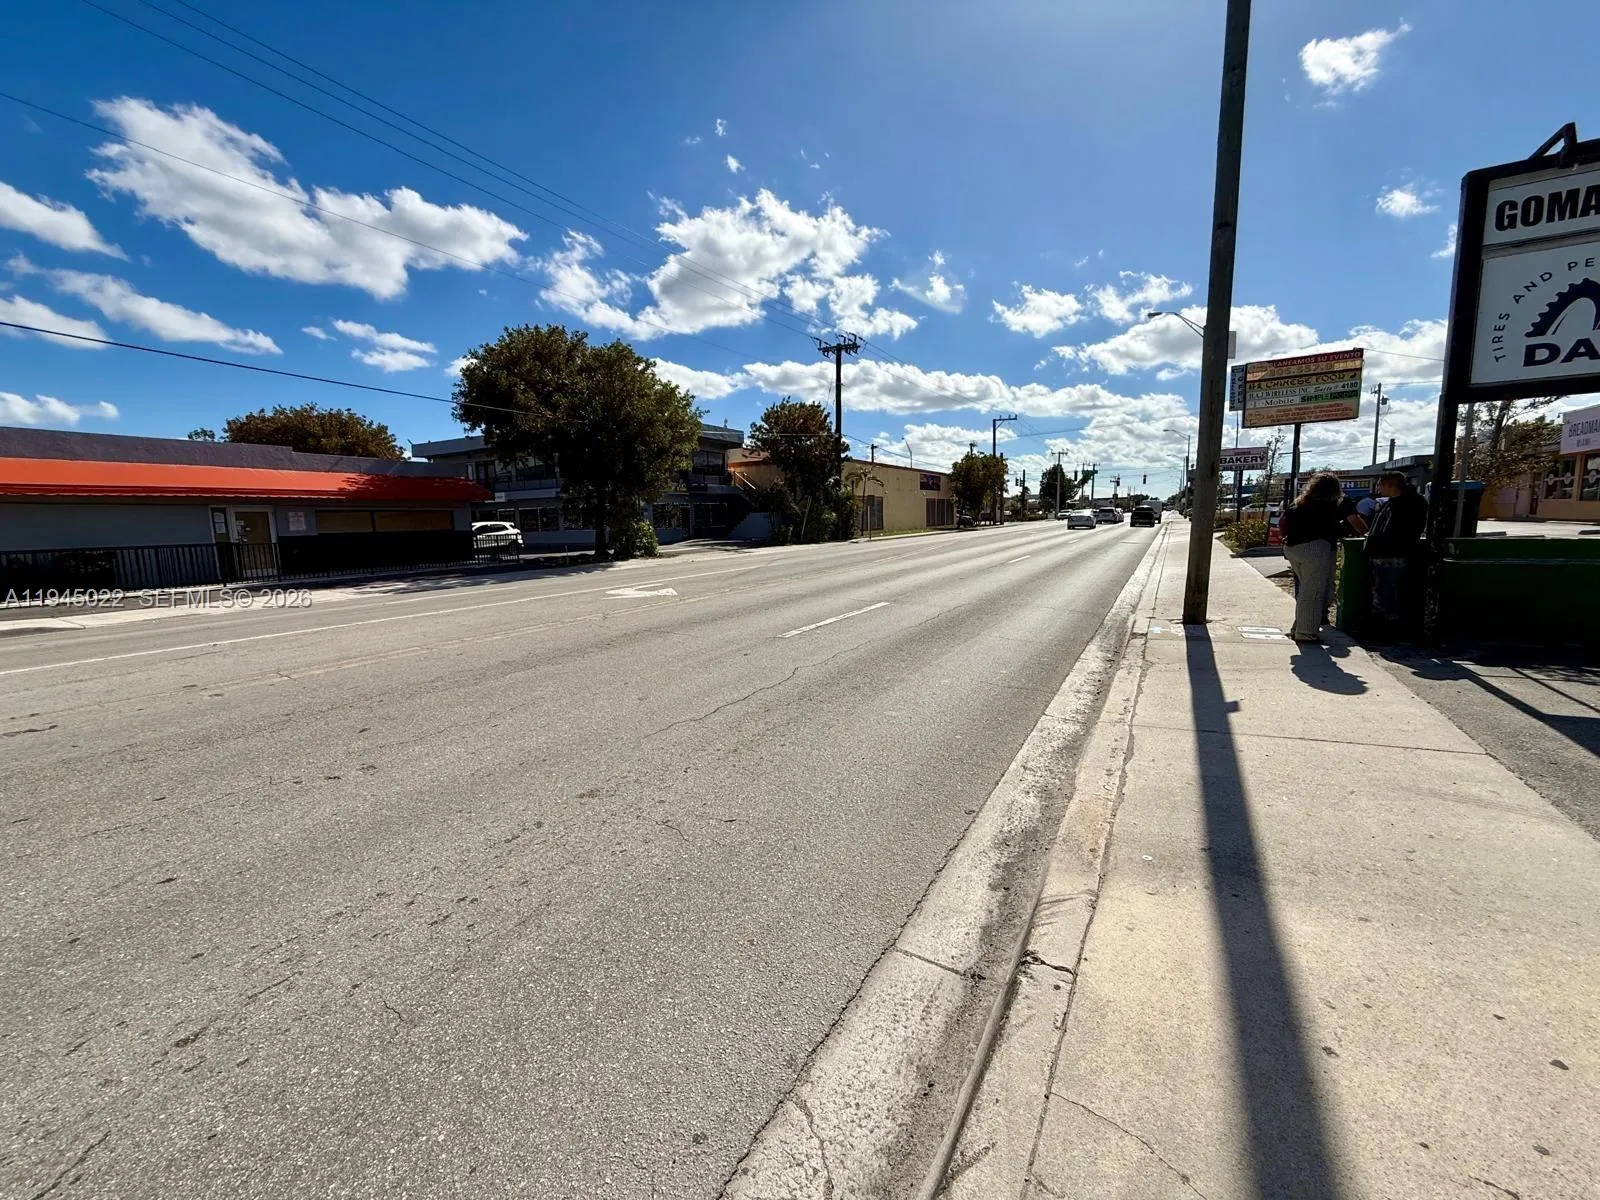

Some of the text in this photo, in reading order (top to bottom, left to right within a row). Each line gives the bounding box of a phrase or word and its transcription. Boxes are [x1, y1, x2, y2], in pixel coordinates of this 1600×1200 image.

[1492, 312, 1510, 363] TIRES
[1512, 271, 1553, 304] AND
[1317, 354, 1328, 362] SU
[1329, 351, 1361, 361] EVENTO
[1266, 376, 1312, 388] CHINESE
[1316, 373, 1346, 383] FOOD
[1266, 387, 1297, 397] WIRELESS
[1220, 455, 1266, 464] BAKERY
